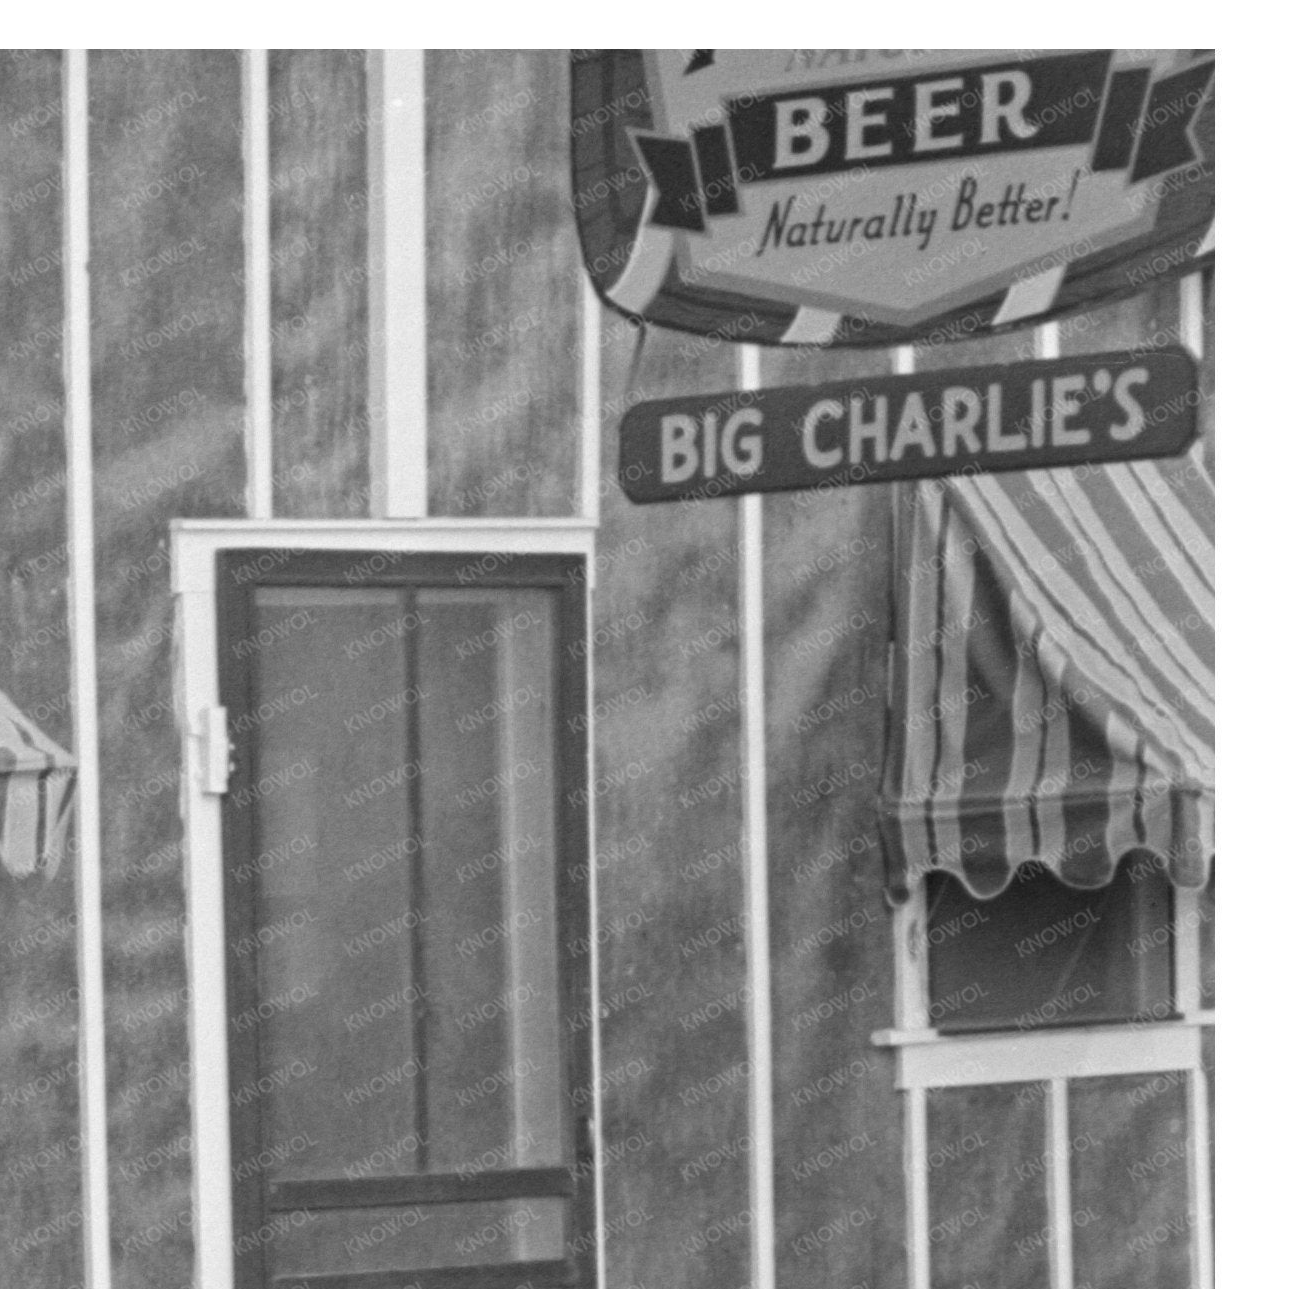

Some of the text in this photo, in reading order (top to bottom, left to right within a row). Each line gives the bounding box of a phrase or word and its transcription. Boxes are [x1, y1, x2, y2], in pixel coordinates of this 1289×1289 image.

[773, 69, 1040, 169] BEER
[757, 169, 1082, 257] Naturally Better!
[661, 367, 1149, 484] BIG CHARLIE'S
